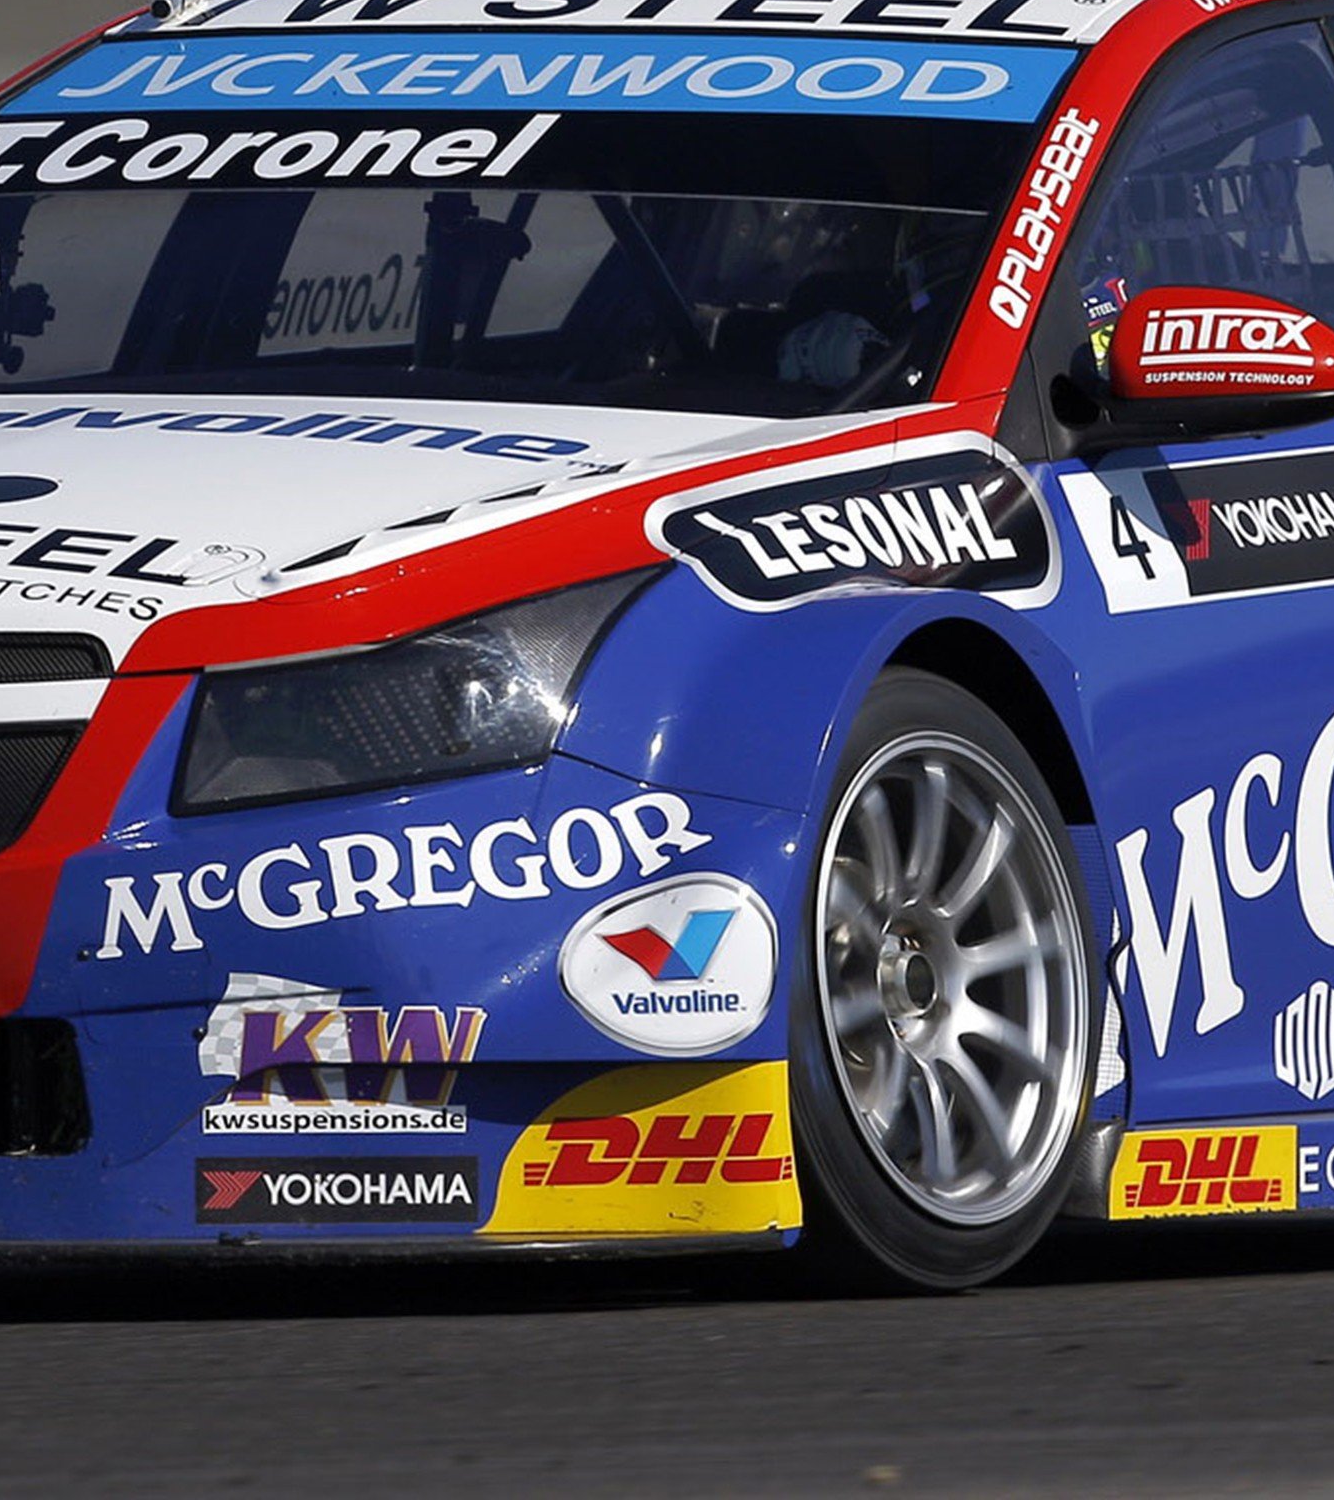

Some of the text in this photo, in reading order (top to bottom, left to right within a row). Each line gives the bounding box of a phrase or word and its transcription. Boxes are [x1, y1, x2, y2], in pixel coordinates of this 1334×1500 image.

[1145, 371, 1315, 386] SUSPENSION TECHNOLOGY
[695, 479, 1018, 580] LESONAL
[1110, 494, 1153, 580] 4
[613, 990, 739, 1016] Valvoline
[225, 1005, 488, 1107] KW
[203, 1107, 466, 1133] kwsuspensions.de
[523, 1113, 794, 1185] DHL
[263, 1171, 472, 1205] YOKOHAMA
[1125, 1135, 1282, 1209] DHL
